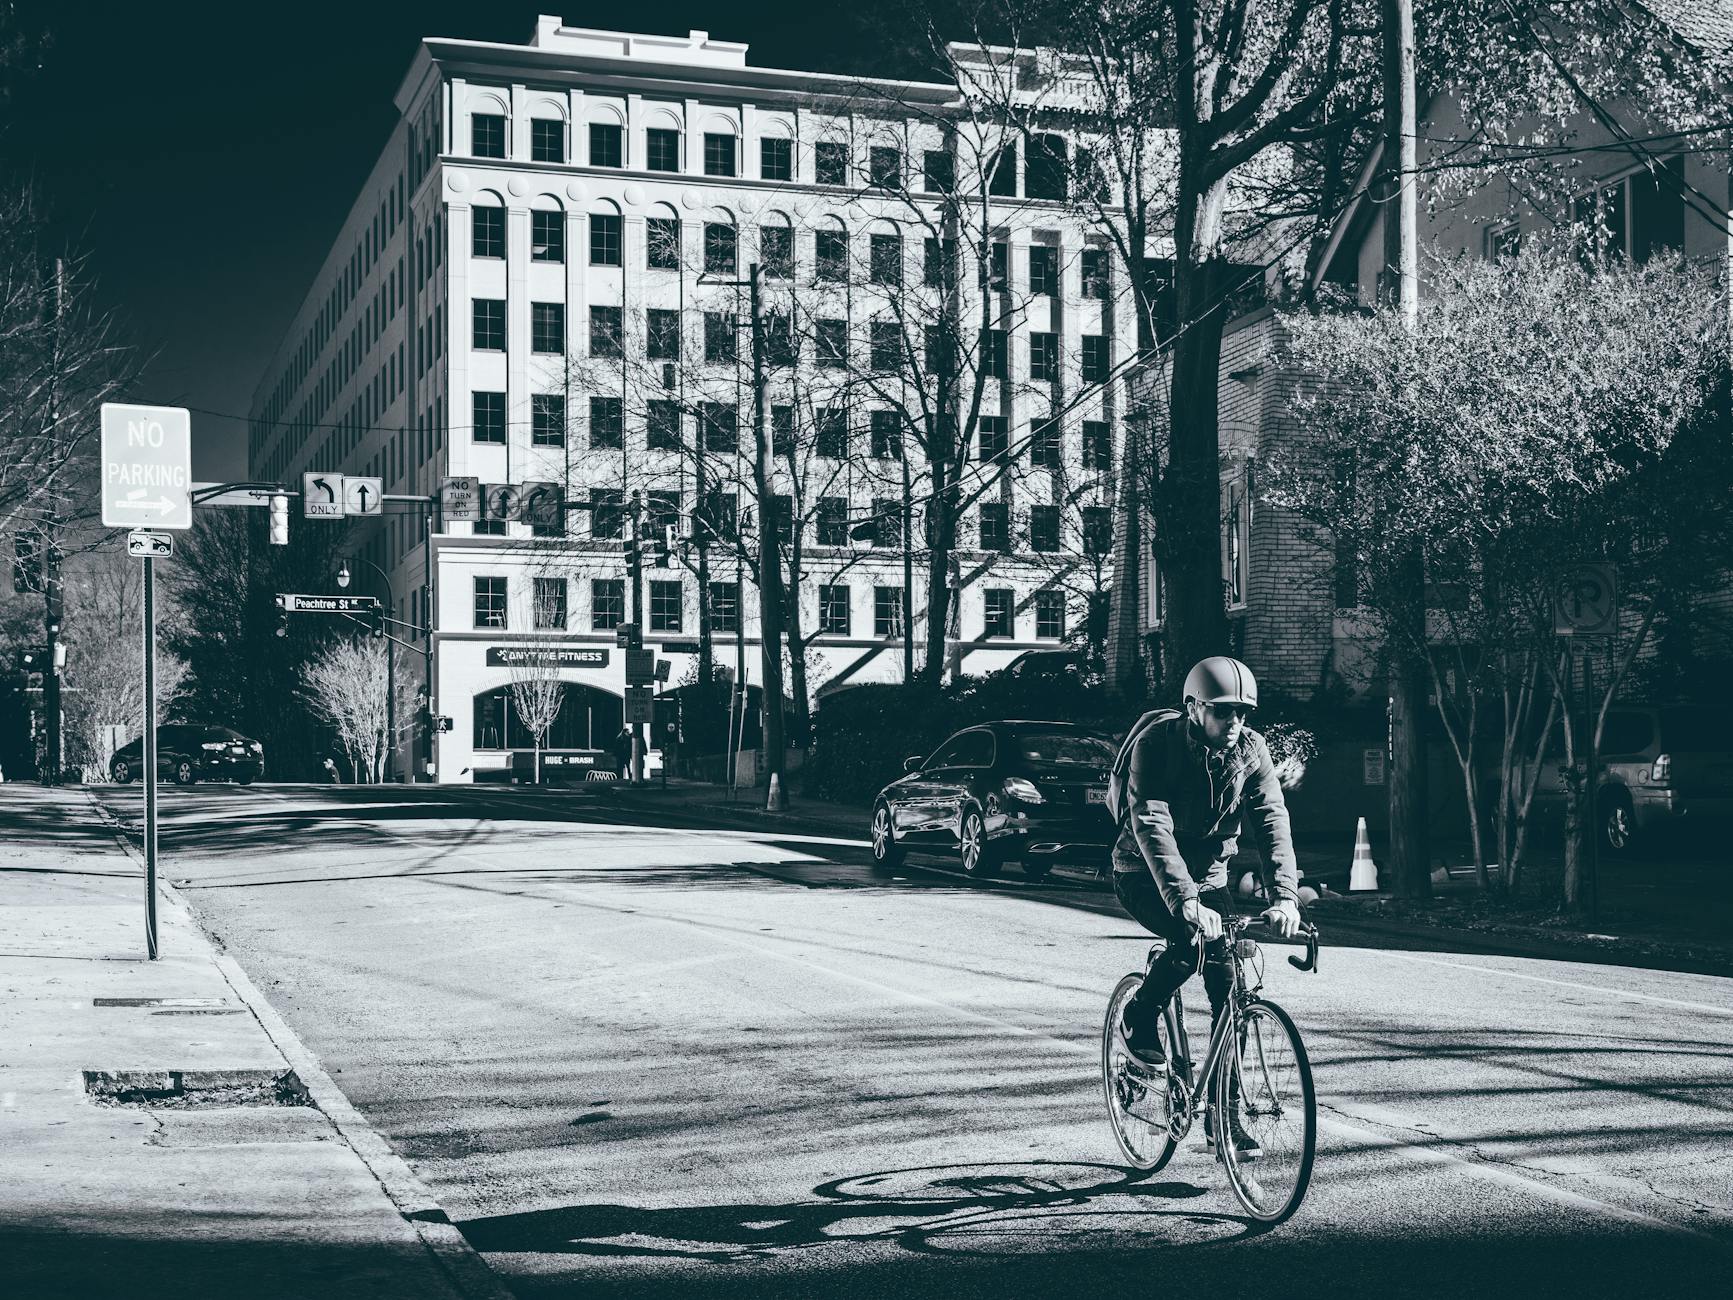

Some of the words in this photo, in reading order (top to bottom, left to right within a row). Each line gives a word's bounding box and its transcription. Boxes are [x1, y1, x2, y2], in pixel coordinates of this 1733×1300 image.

[127, 420, 164, 448] NO
[108, 462, 185, 488] PARKING
[451, 481, 469, 491] NO
[310, 505, 338, 515] ONLY
[526, 513, 552, 522] ONLY
[295, 598, 336, 609] Peachtree
[339, 599, 349, 609] St
[558, 652, 602, 661] FITNESS
[544, 755, 563, 765] HUGE
[569, 756, 594, 765] BRASH
